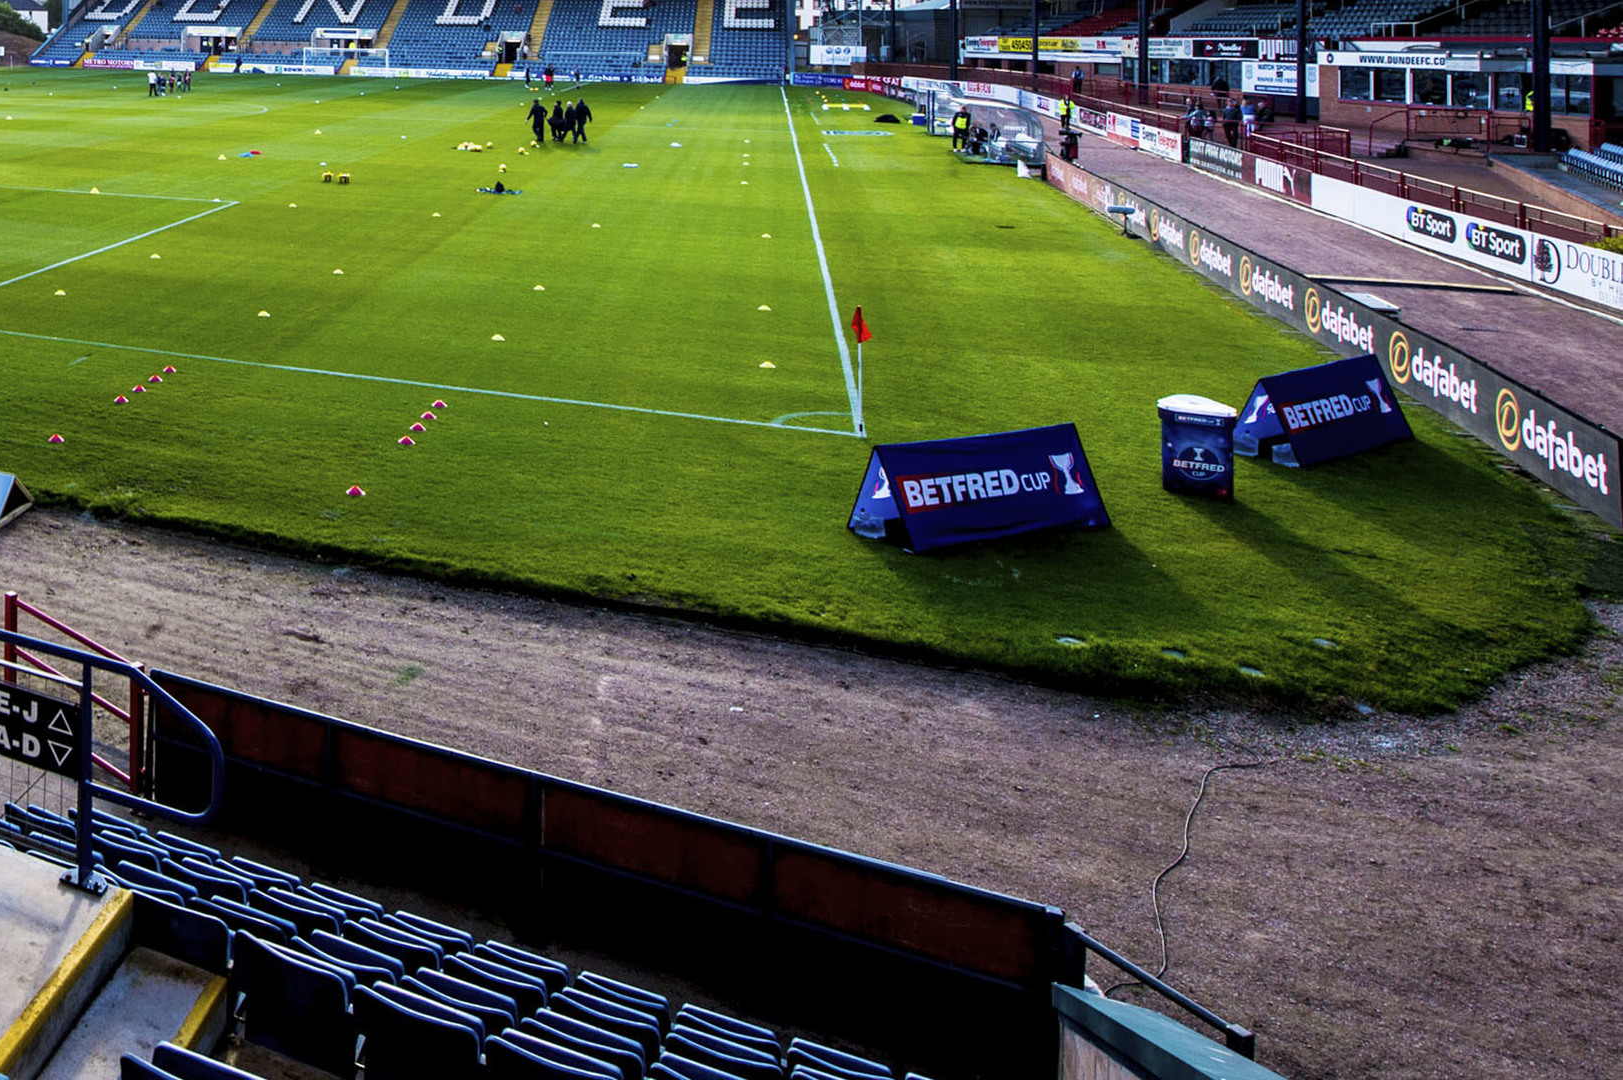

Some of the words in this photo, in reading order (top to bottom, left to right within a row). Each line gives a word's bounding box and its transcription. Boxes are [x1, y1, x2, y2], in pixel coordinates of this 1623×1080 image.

[83, 58, 106, 66] METRO
[1011, 39, 1033, 50] 450450
[1359, 55, 1446, 66] WWW.DUNDEEFC.CO
[1142, 126, 1157, 143] Evening
[1157, 131, 1178, 151] Telegraph
[1159, 216, 1184, 251] dafabet
[1411, 213, 1427, 229] BT
[1426, 214, 1451, 238] Sport
[1200, 239, 1232, 278] dafabet
[1472, 228, 1489, 248] BT
[1489, 231, 1521, 259] Sport
[1567, 244, 1623, 284] DOUBL
[1251, 265, 1294, 311] dafabet
[1321, 300, 1374, 354] dafabet
[1411, 347, 1478, 414] dafabet
[1178, 415, 1207, 423] BETFRED
[1283, 394, 1354, 430] BETFRED
[1353, 395, 1371, 412] CUP
[1173, 459, 1225, 472] BETFRED
[1522, 409, 1609, 495] dafabet
[903, 469, 1020, 508] BETFRED
[1021, 471, 1051, 492] CUP
